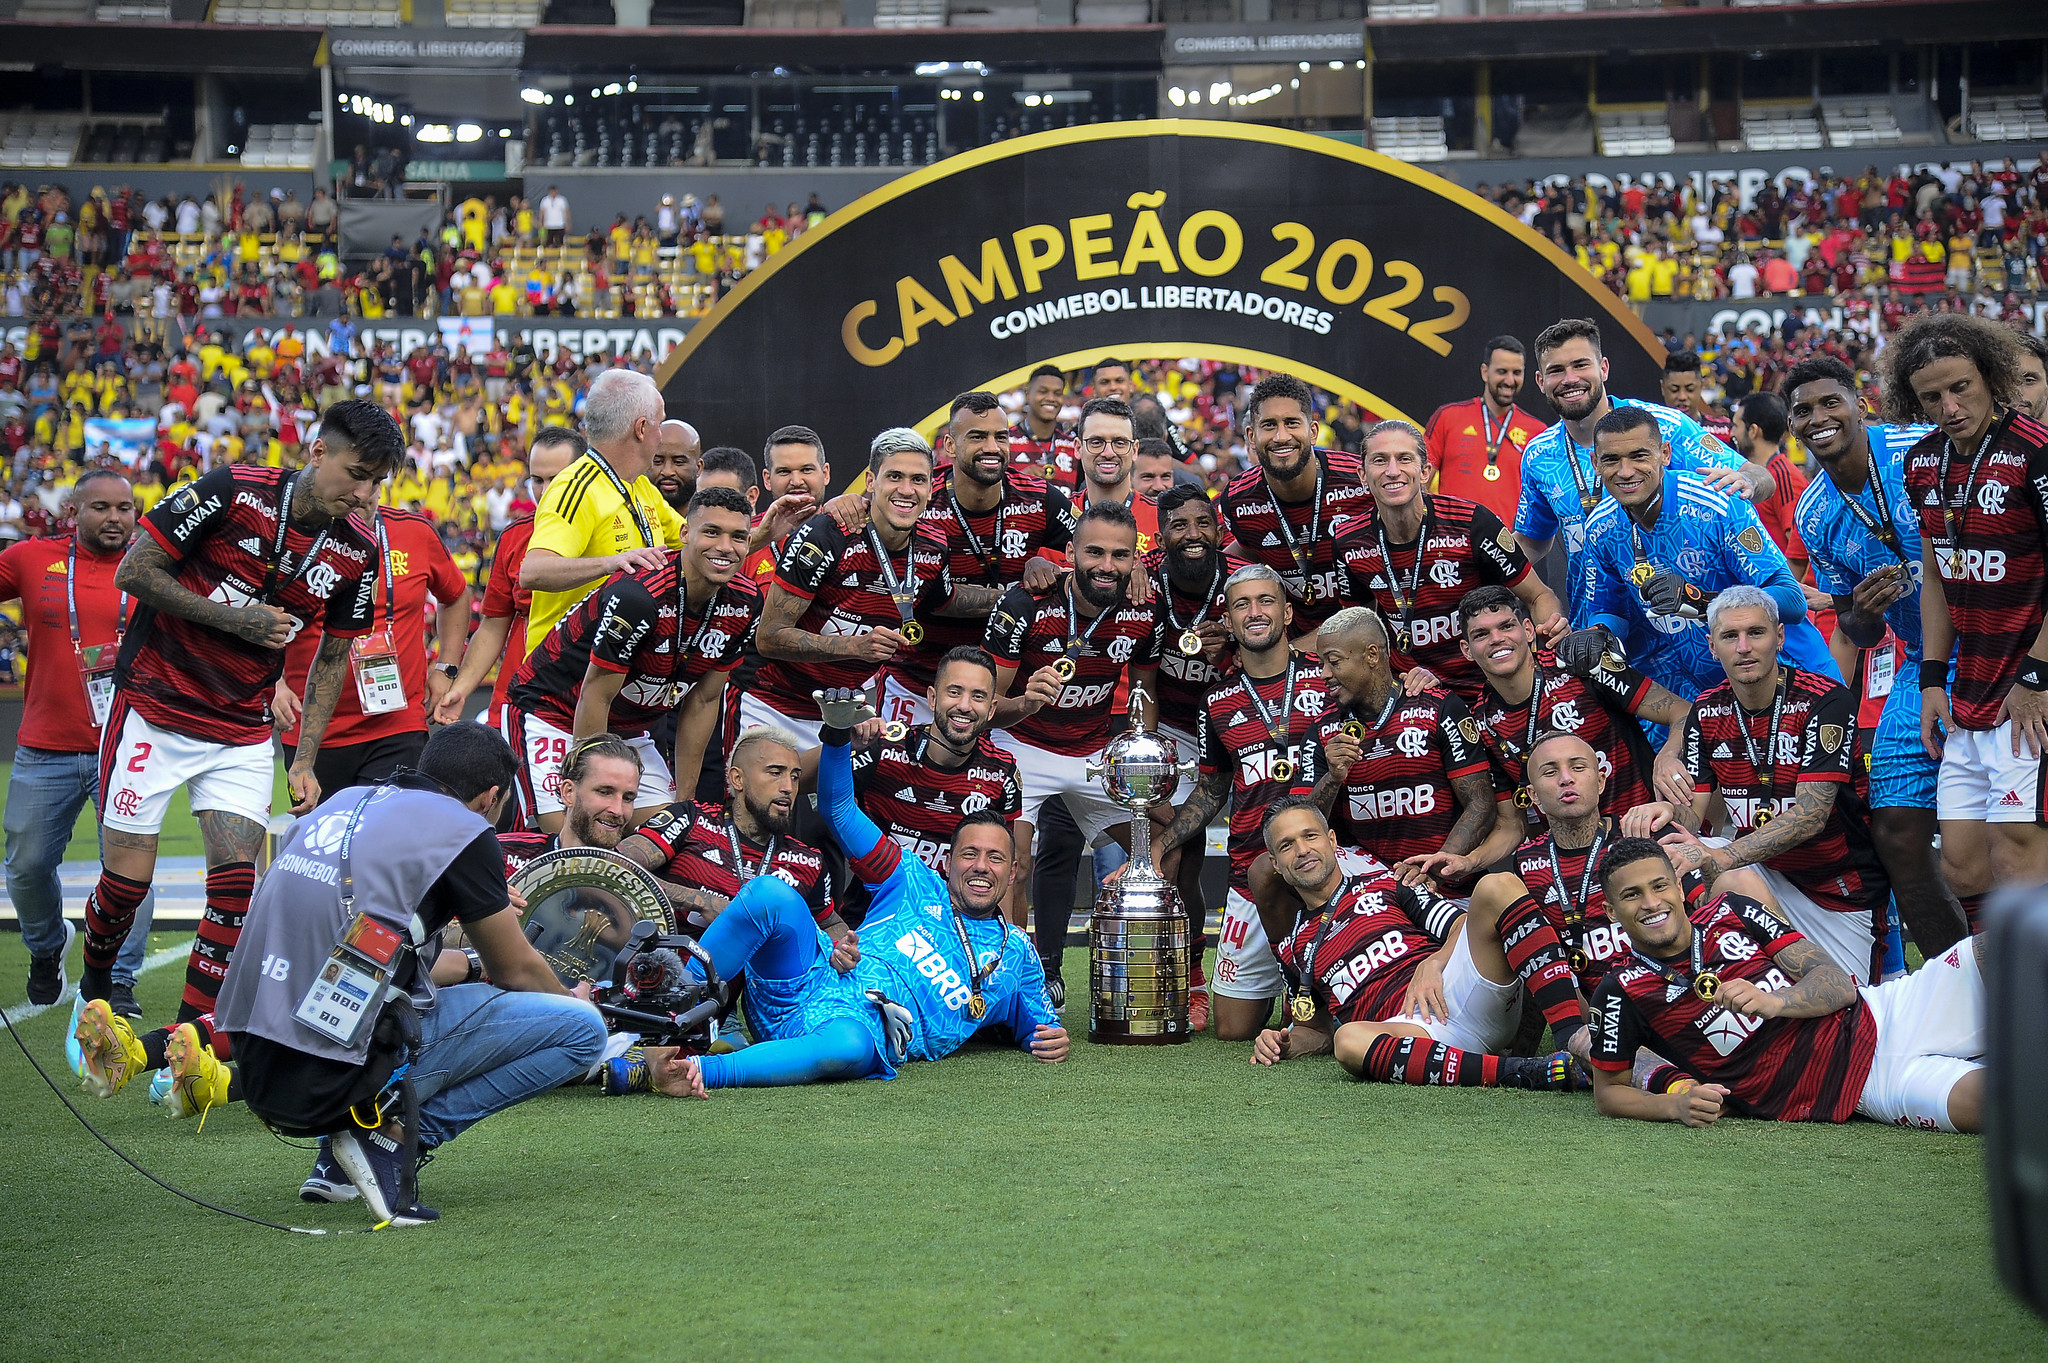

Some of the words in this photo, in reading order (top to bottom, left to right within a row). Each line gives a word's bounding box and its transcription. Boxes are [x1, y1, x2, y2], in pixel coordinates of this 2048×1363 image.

[331, 39, 415, 56] CONMEBOL
[418, 39, 524, 56] LIBERTADORES
[1175, 36, 1254, 52] CONMEBOL
[1258, 33, 1363, 50] LIBERTADORES
[841, 189, 1243, 367] CAMPEÃO
[1260, 222, 1471, 358] 2022
[990, 286, 1136, 341] CONMEBOL
[1140, 285, 1334, 335] LIBERTADORES
[1526, 439, 1558, 468] pixbet
[1963, 473, 1974, 505] CONMEBOL
[1971, 434, 1992, 473] LIBERTADORES
[235, 491, 278, 522] pixbet
[1002, 500, 1044, 519] pixbet
[1236, 501, 1275, 518] pixbet
[1326, 485, 1370, 505] pixbet
[1876, 491, 1888, 522] CONMEBOL
[173, 494, 222, 541] HAVAN
[274, 519, 287, 553] CONMEBOL
[283, 481, 294, 520] LIBERTADORES
[1311, 513, 1319, 541] CONMEBOL
[1851, 500, 1874, 527] CONMEBOL
[1427, 534, 1468, 551] pixbet
[1590, 514, 1619, 546] pixbet
[322, 537, 368, 564] pixbet
[781, 523, 813, 573] HAVAN
[1344, 545, 1382, 564] pixbet
[1479, 537, 1518, 577] HAVAN
[1725, 530, 1758, 577] HAVAN
[1411, 563, 1420, 590] CONMEBOL
[1957, 549, 2007, 583] BRB
[225, 573, 256, 594] banco
[352, 570, 374, 619] HAVAN
[832, 606, 862, 621] banco
[1115, 609, 1153, 623] pixbet
[618, 619, 650, 661] HAVAN
[890, 697, 916, 725] 15
[1199, 710, 1208, 759] HAVAN
[1440, 715, 1466, 762] HAVAN
[1527, 715, 1536, 745] CONMEBOL
[1767, 733, 1777, 765] CONMEBOL
[1773, 695, 1782, 733] LIBERTADORES
[1839, 714, 1856, 769] HAVAN
[127, 742, 152, 772] 2
[534, 737, 567, 764] 29
[1237, 742, 1265, 756] banco
[1687, 726, 1700, 777] HAVAN
[1827, 741, 1834, 750] 2
[1302, 739, 1317, 783] HAVAN
[1347, 784, 1375, 793] banco
[1377, 784, 1435, 818] BRB
[1721, 786, 1748, 796] banco
[890, 822, 921, 837] banco
[279, 853, 338, 885] CONMEBOL
[777, 851, 822, 870] pixbet
[1579, 877, 1590, 903] CONMEBOL
[954, 916, 967, 943] CONMEBOL
[963, 942, 978, 978] LIBERTADORES
[1223, 915, 1249, 950] 14
[688, 940, 710, 964] RONIN
[1349, 930, 1409, 984] BRB
[916, 952, 974, 1011] BRB
[1321, 958, 1345, 984] banco
[1603, 994, 1622, 1054] HAVAN
[1694, 1004, 1724, 1029] banc
[1446, 1051, 1458, 1084] CRF
[368, 1131, 398, 1153] PUMA
